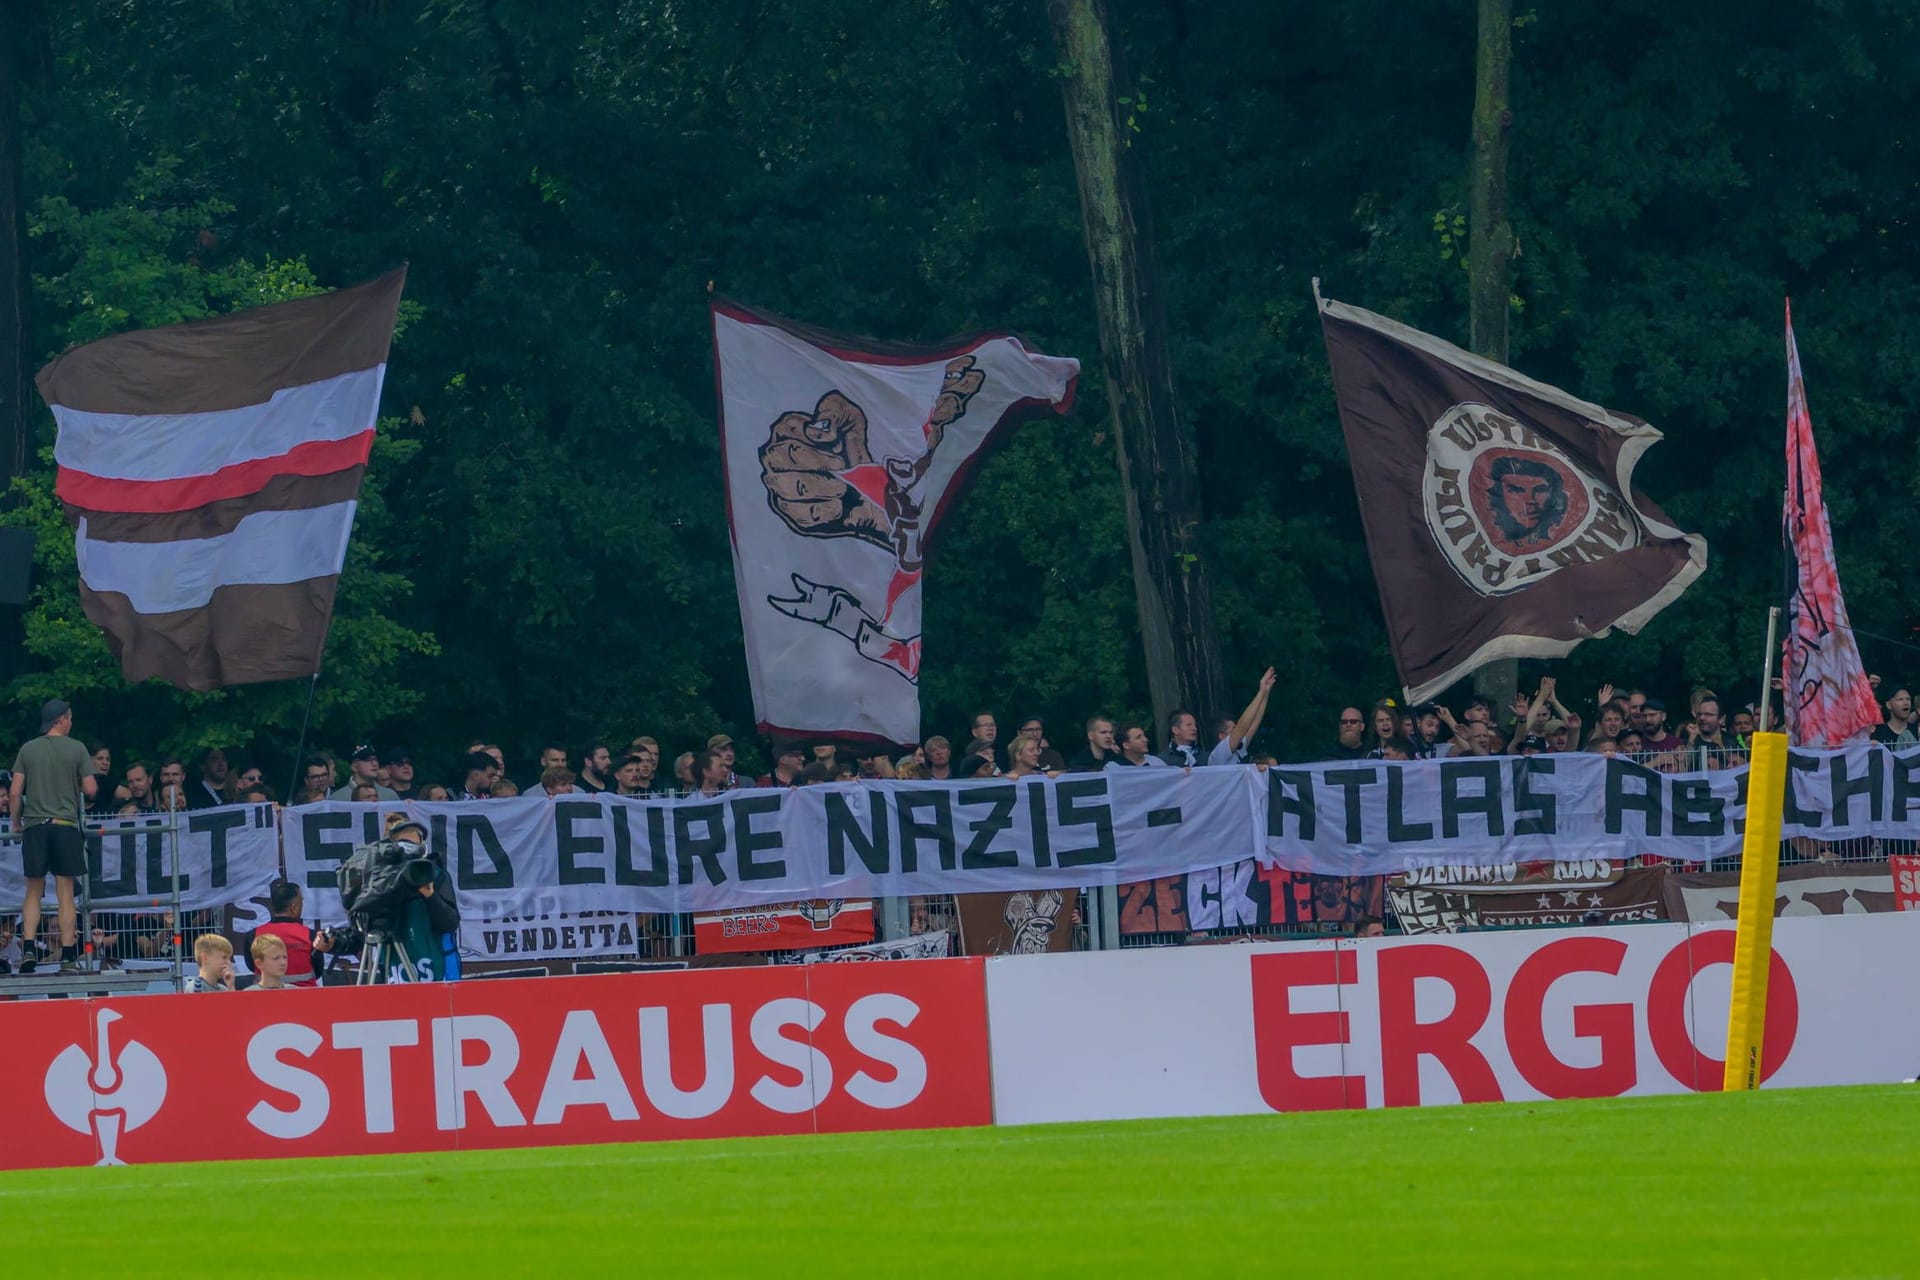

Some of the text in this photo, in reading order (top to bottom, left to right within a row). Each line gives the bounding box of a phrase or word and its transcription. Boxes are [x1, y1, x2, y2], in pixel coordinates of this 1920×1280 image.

[1441, 413, 1562, 453] ULTR
[555, 794, 787, 886] EURE
[824, 777, 1116, 875] NAZIS
[1147, 806, 1182, 828] -
[1266, 758, 1557, 845] ATLAS
[1605, 748, 1920, 838] ABCH
[483, 923, 634, 954] VENDETTA
[722, 914, 780, 938] BEERS
[1250, 930, 1799, 1113] ERGO
[246, 992, 928, 1141] STRAUSS
